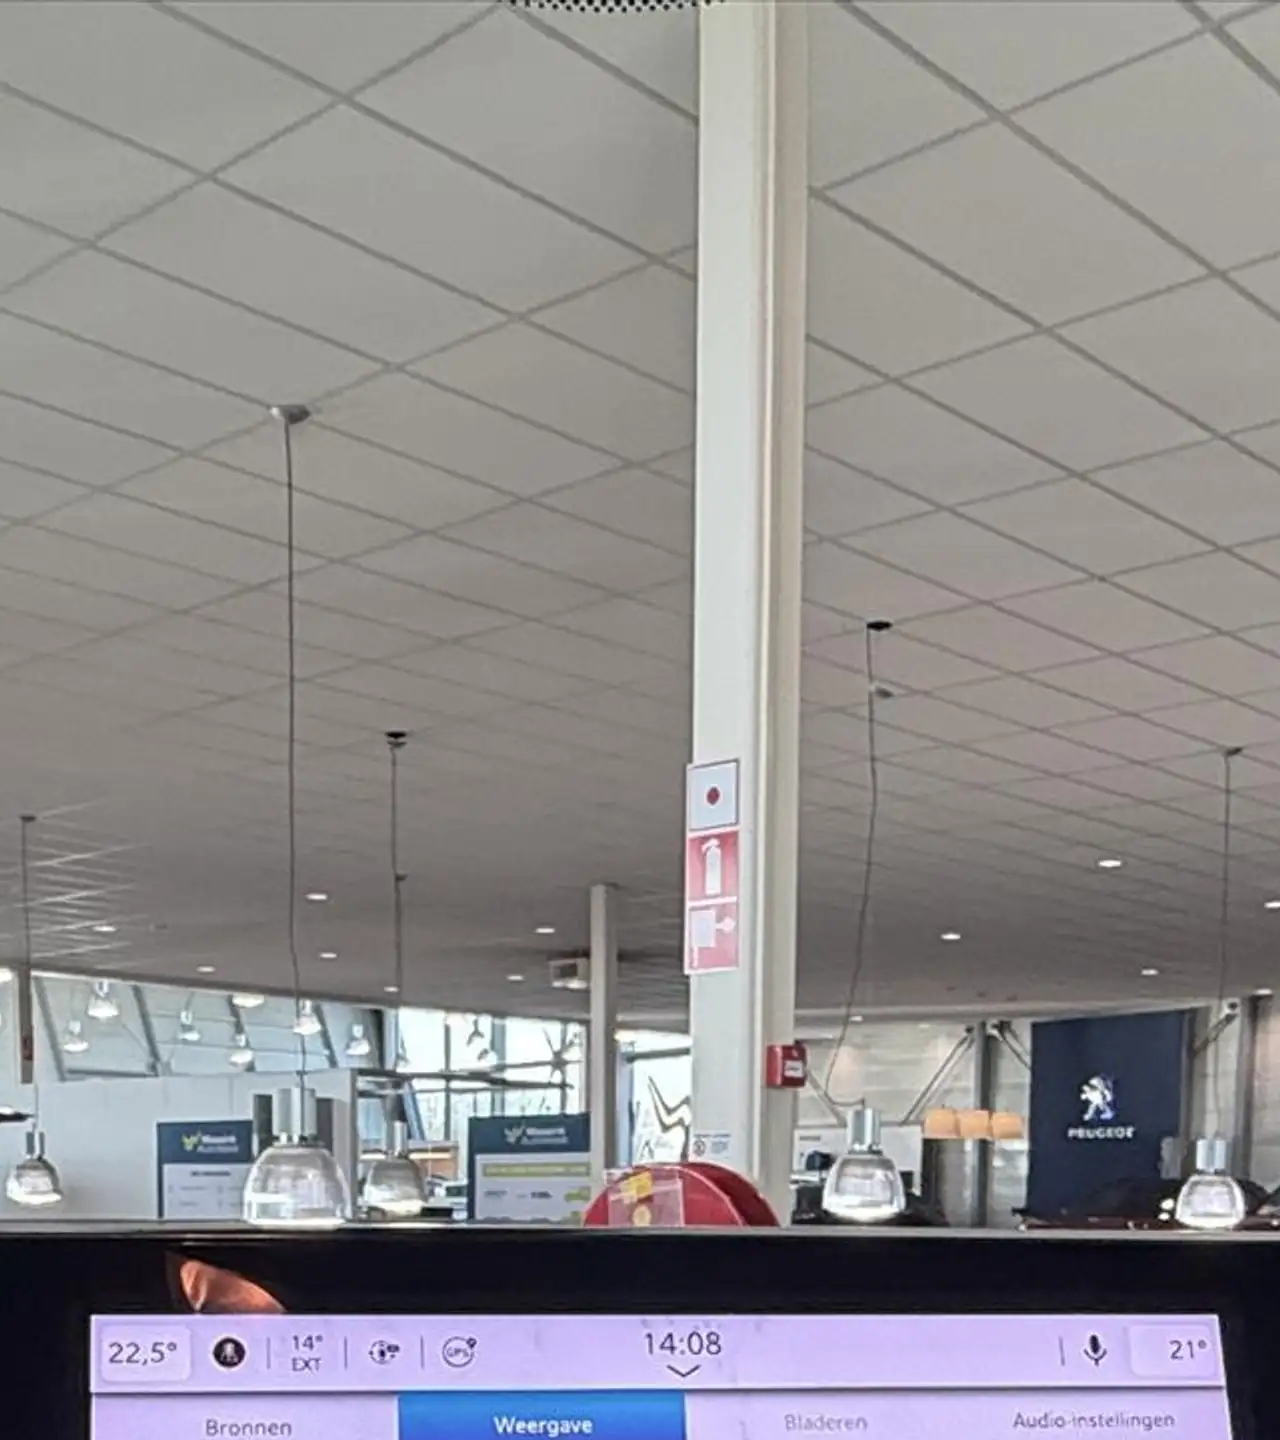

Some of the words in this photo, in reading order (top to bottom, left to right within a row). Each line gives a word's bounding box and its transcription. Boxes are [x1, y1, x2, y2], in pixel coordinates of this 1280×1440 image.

[1067, 1126, 1134, 1139] PEUGEOT
[107, 1340, 178, 1367] 22,5°
[644, 1331, 722, 1356] 14:08
[1169, 1339, 1208, 1361] 21°
[292, 1357, 322, 1372] EXT
[205, 1419, 293, 1437] Bronnen
[493, 1415, 593, 1437] Weergave
[784, 1413, 869, 1431] Bladeren
[1012, 1410, 1177, 1434] Audio-instellingen
